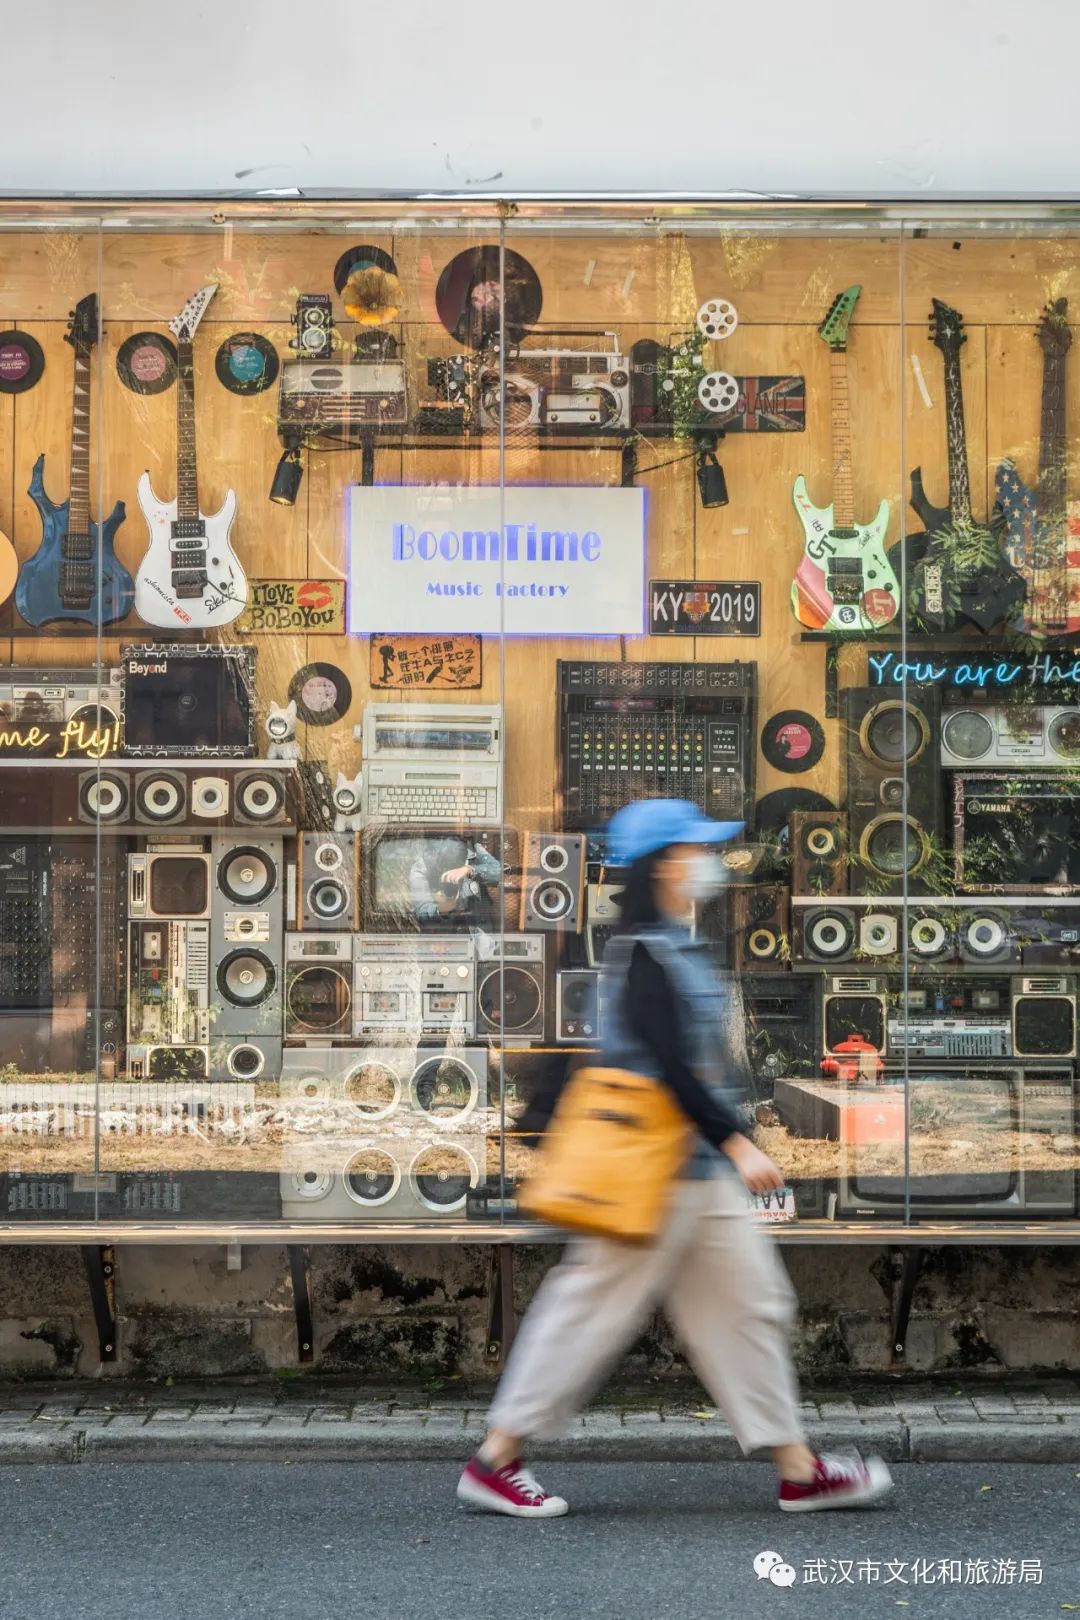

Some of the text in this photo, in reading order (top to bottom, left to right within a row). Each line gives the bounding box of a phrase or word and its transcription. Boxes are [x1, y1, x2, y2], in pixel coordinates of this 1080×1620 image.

[392, 523, 601, 561] BoomTime
[426, 582, 483, 597] Music
[653, 592, 755, 622] KY 2019
[129, 661, 167, 677] Beyond
[869, 653, 946, 684] You
[954, 662, 1021, 687] are
[56, 720, 119, 758] fly!
[981, 803, 1011, 813] YAMAHA
